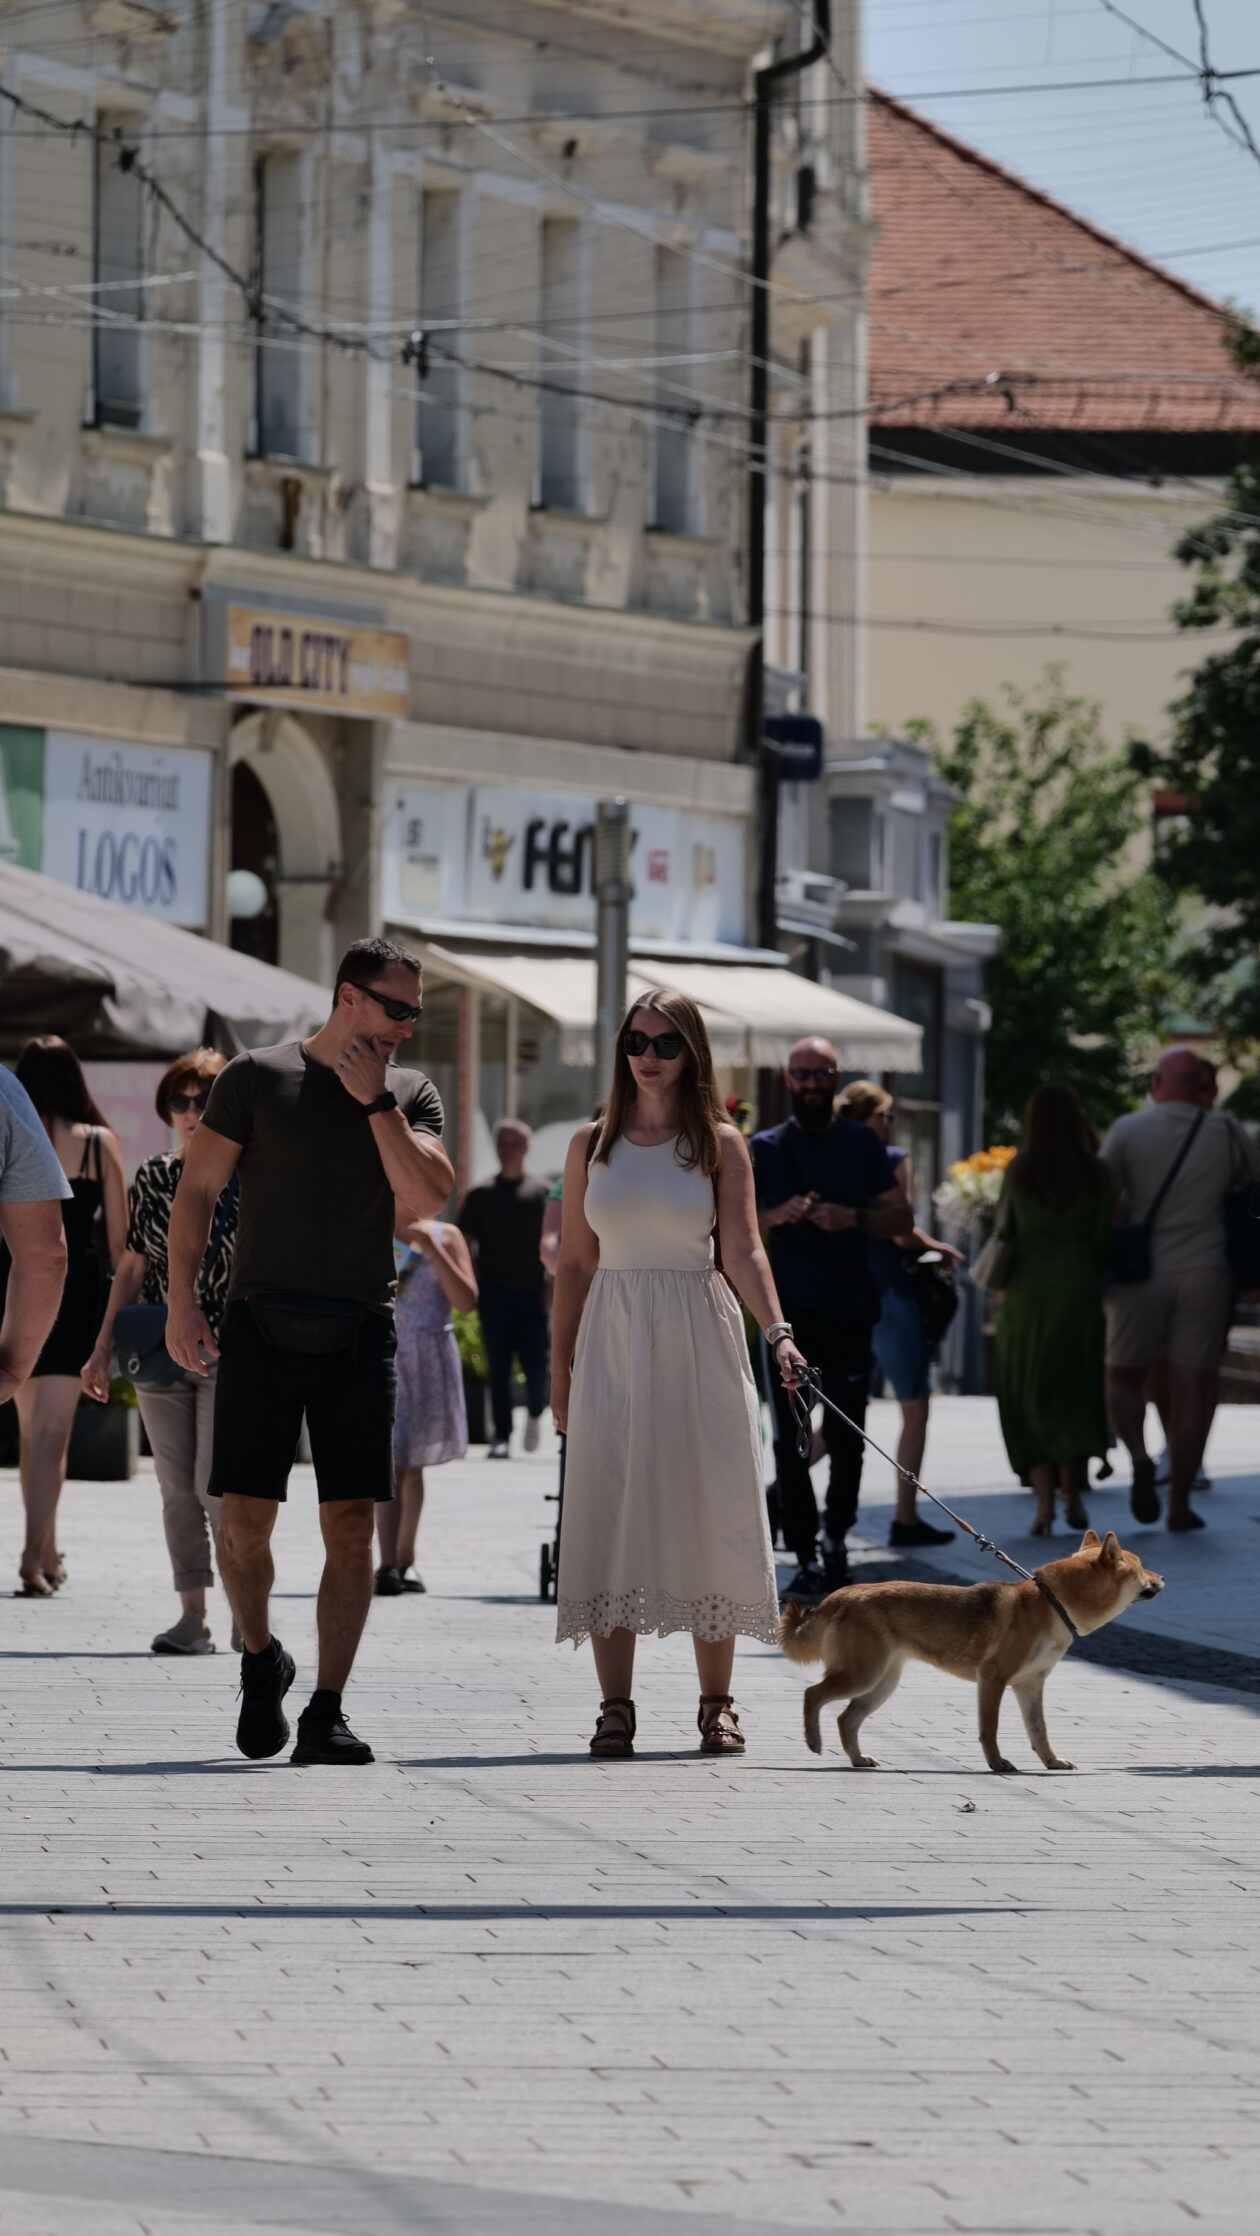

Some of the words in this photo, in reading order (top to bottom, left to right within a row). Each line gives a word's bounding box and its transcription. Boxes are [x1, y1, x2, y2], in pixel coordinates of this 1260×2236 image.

[252, 623, 293, 687] OLD
[302, 630, 353, 695] CITY
[75, 828, 178, 906] LOGOS
[523, 817, 638, 899] FEN
